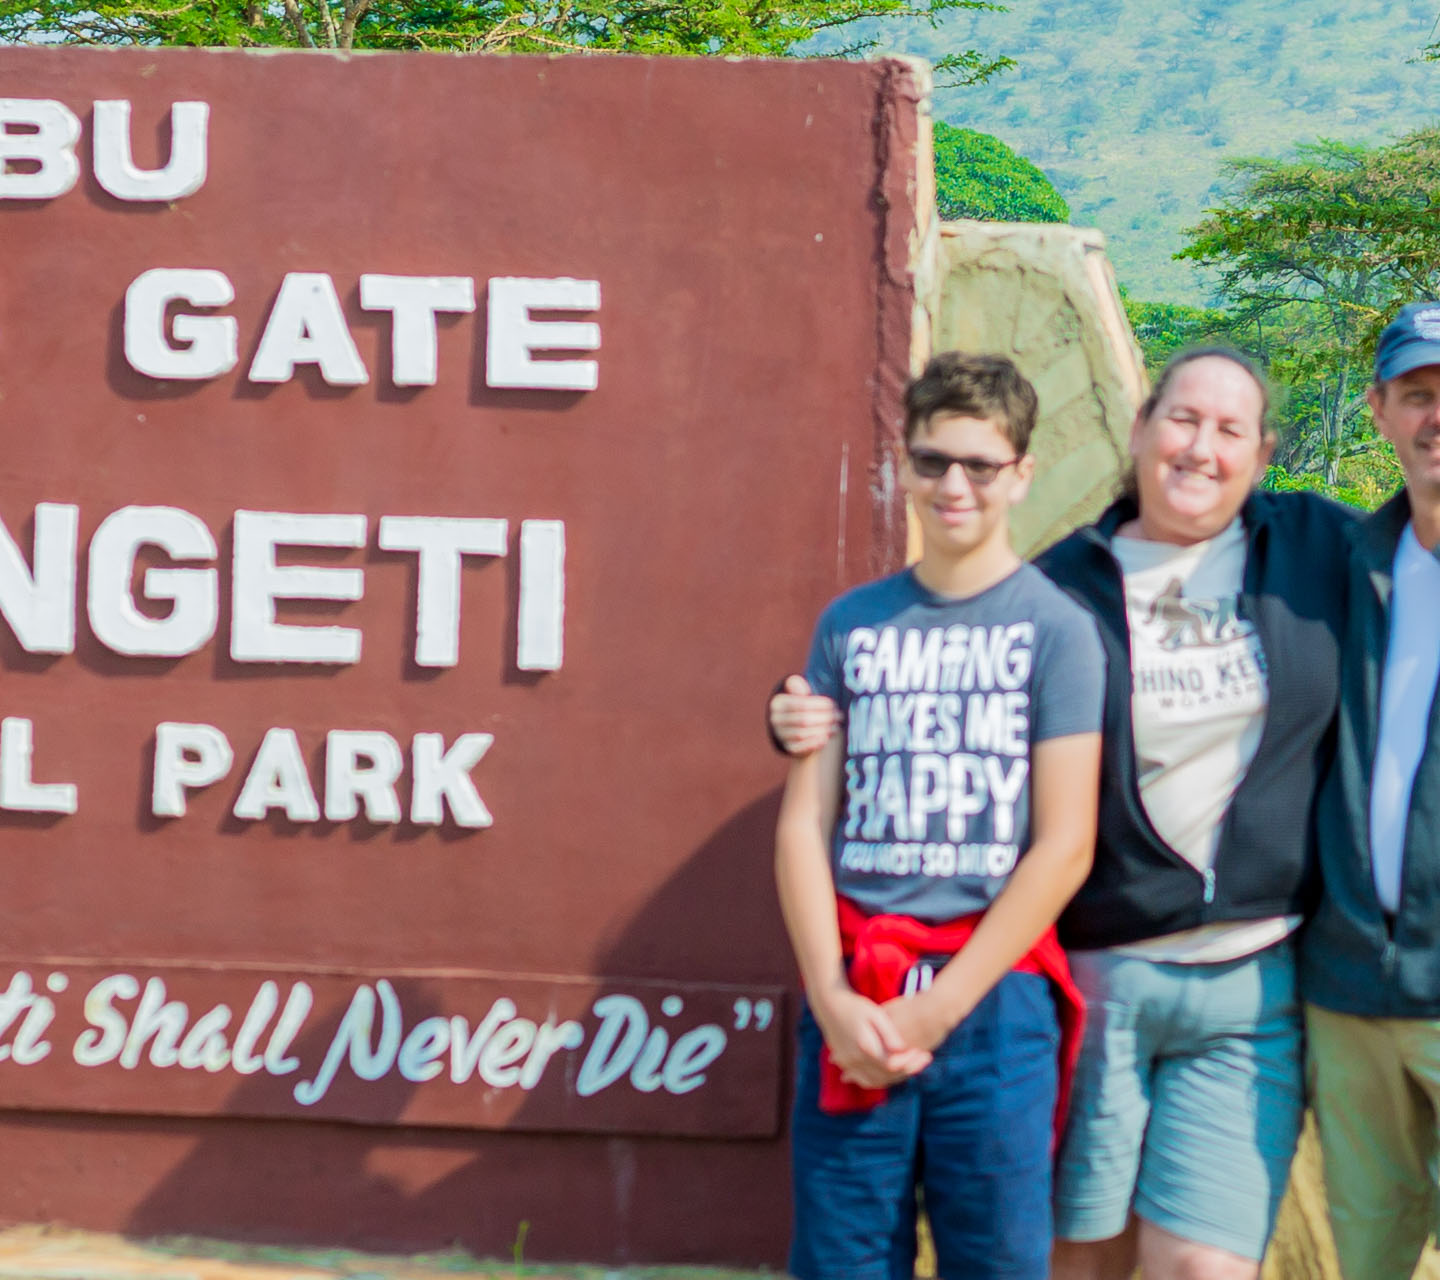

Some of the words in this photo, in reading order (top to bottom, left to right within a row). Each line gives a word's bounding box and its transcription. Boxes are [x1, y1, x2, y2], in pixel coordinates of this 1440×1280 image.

[122, 267, 601, 390] GATE
[847, 693, 961, 756] MAKES
[964, 691, 1029, 756] ME
[152, 721, 495, 829] PARK
[844, 752, 1030, 842] HAPPY
[922, 841, 957, 877] SO
[72, 974, 314, 1075] Shall
[293, 979, 584, 1106] Never
